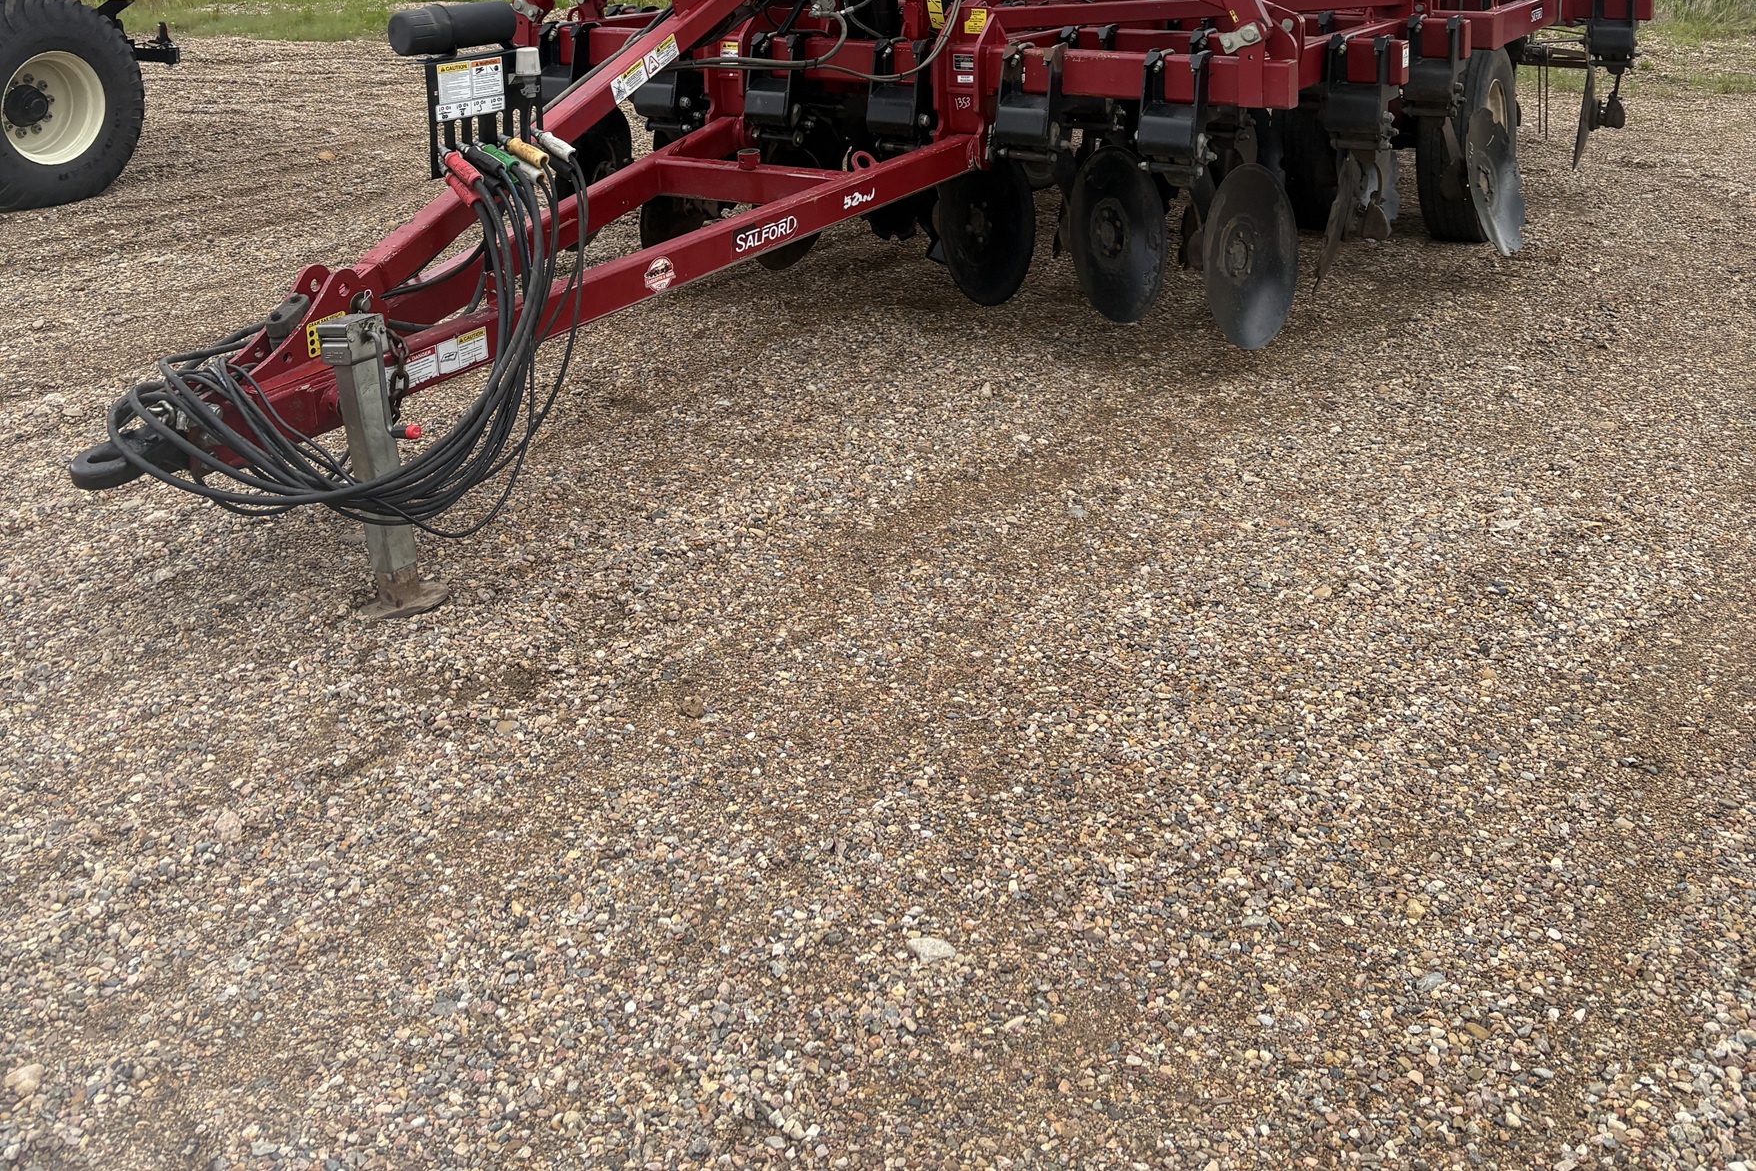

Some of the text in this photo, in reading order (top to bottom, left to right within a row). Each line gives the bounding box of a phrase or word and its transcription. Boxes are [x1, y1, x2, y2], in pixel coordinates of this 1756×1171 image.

[445, 64, 468, 72] CAUTION
[954, 96, 971, 110] 1353
[735, 215, 798, 253] SALFORD
[462, 330, 484, 342] CAUTION
[411, 349, 432, 362] DANGER
